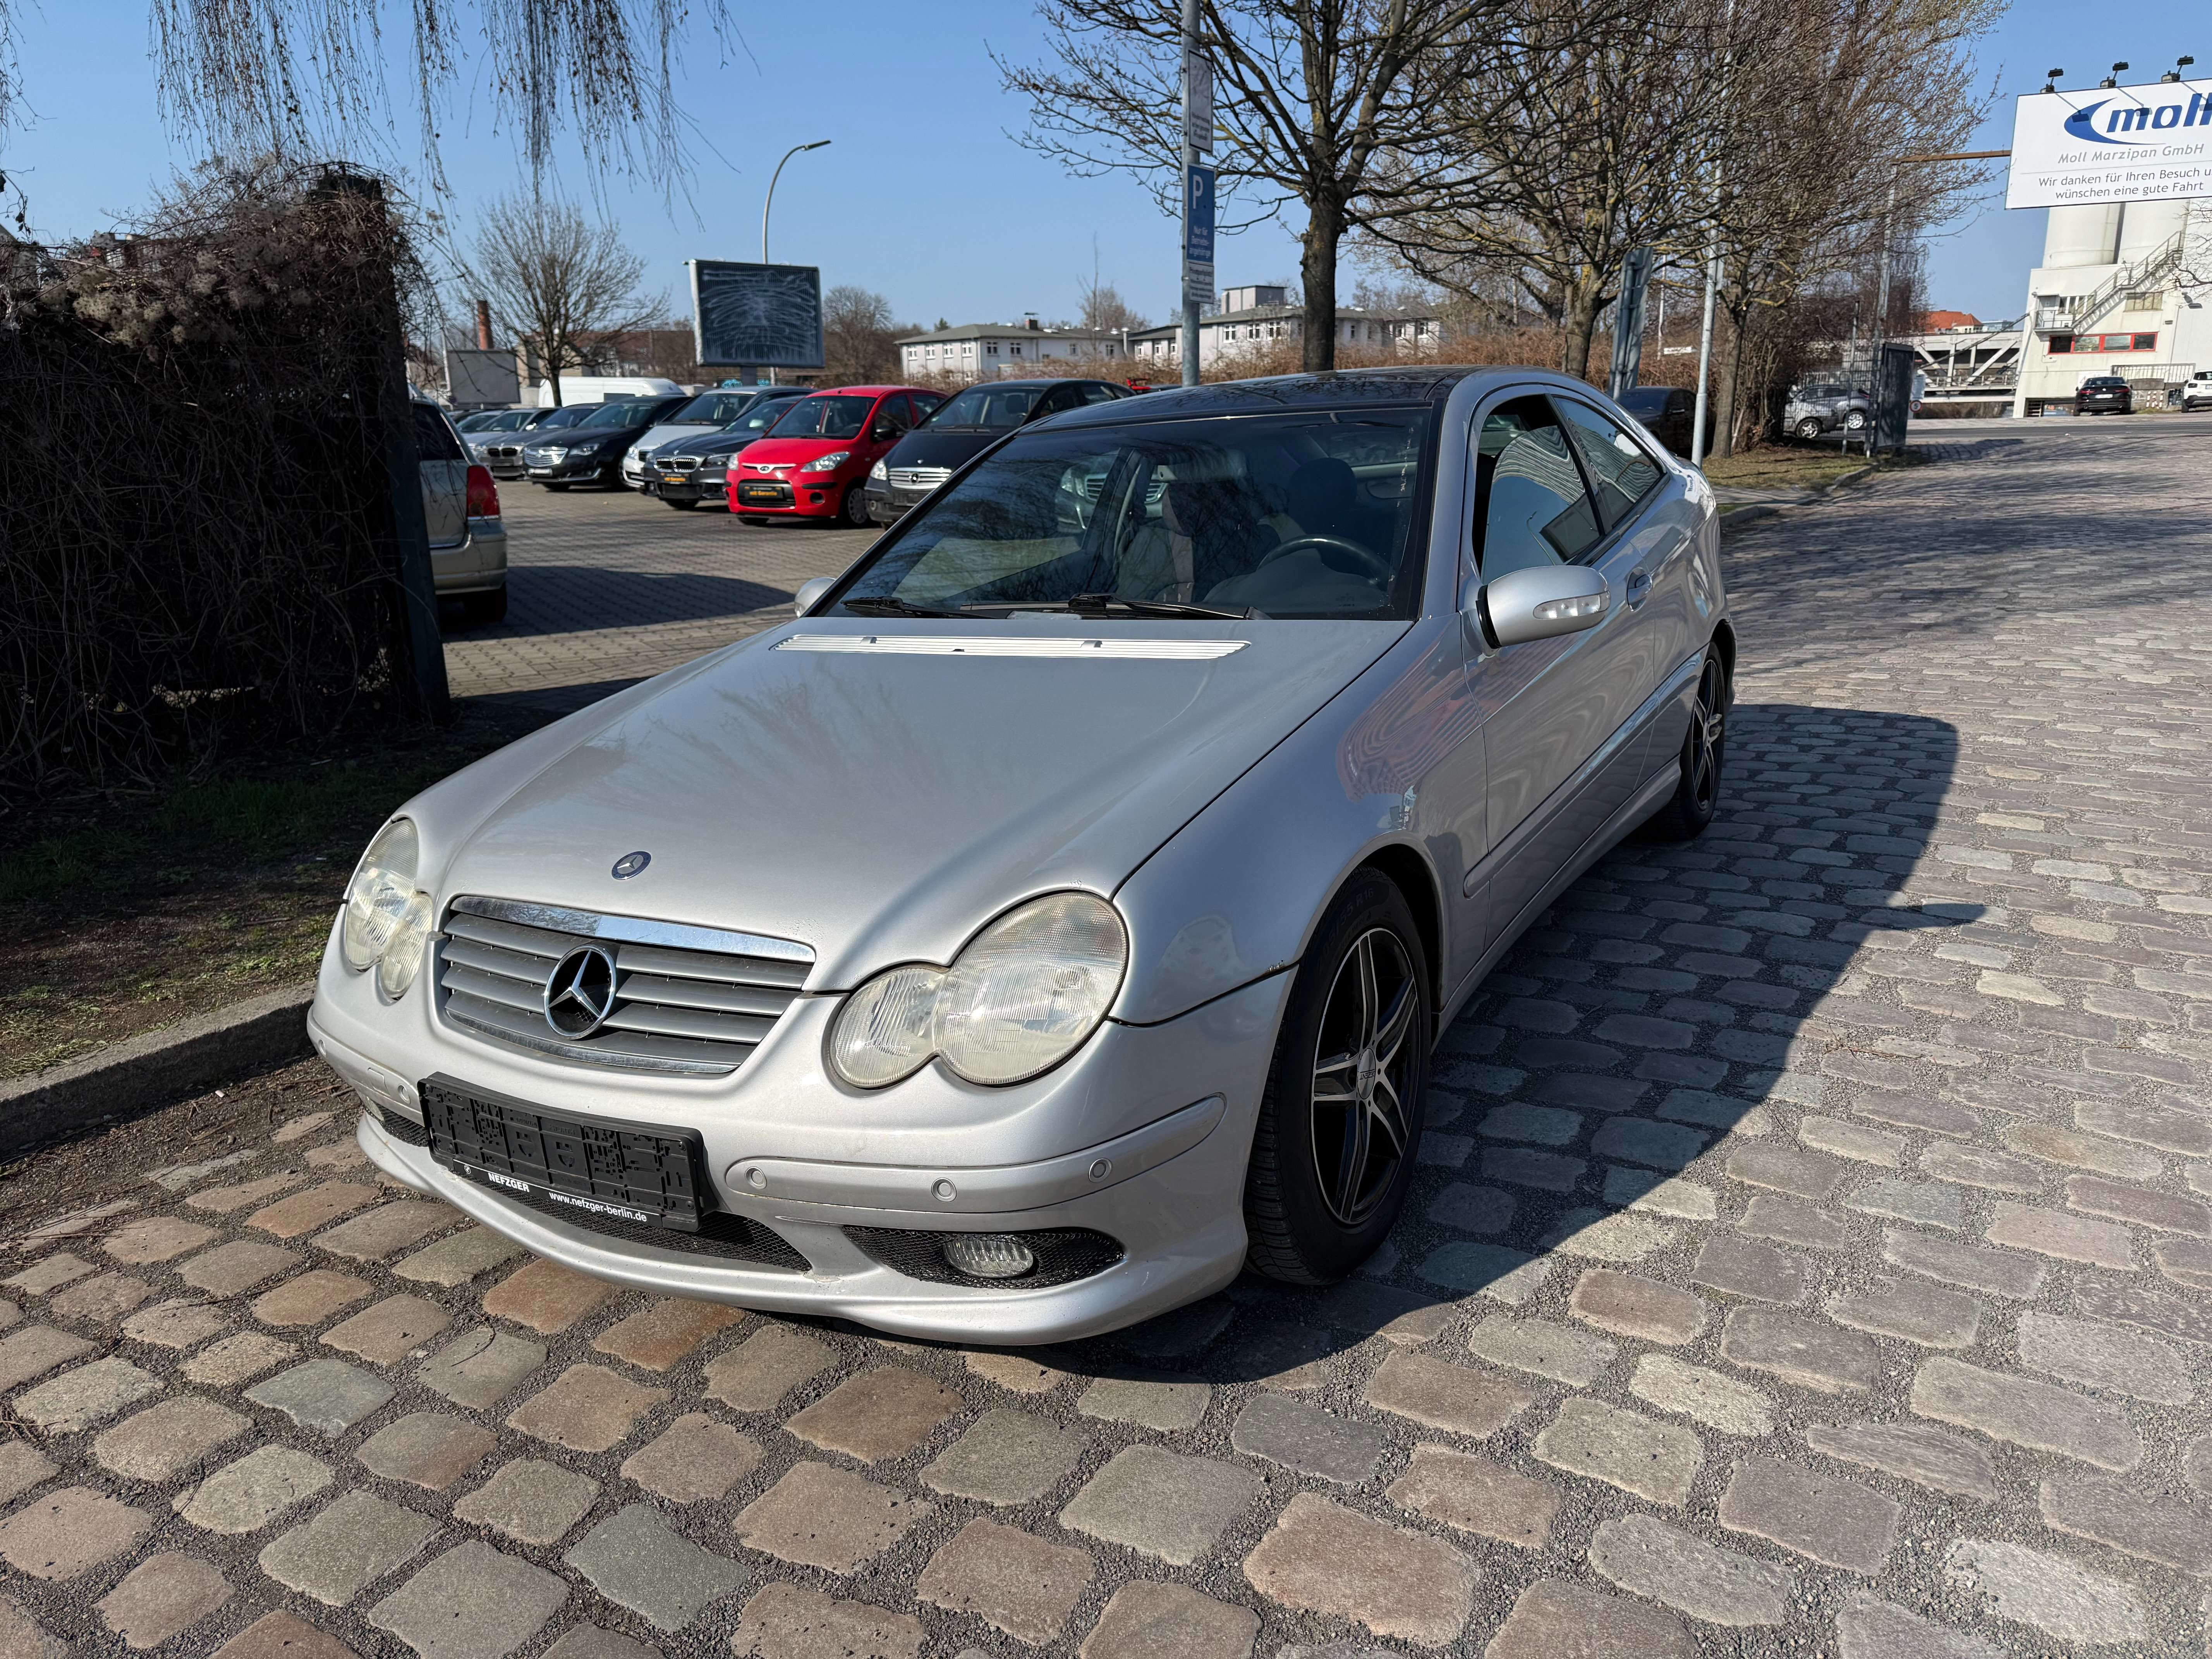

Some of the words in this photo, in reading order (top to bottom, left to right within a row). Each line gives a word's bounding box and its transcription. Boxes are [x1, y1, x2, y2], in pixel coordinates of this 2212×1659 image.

[2106, 92, 2212, 133] moll
[2057, 152, 2087, 164] Moll
[2092, 148, 2157, 161] Marzipan
[2162, 143, 2205, 156] GmbH
[2039, 177, 2057, 187] Wir
[2061, 175, 2101, 185] danken
[2106, 172, 2122, 183] für
[2126, 171, 2155, 181] Ihren
[2159, 167, 2200, 179] Besuch
[1193, 175, 1203, 209] P
[2055, 187, 2110, 199] wünschen
[2114, 185, 2138, 195] eine
[2142, 184, 2168, 196] gute
[2172, 181, 2204, 192] Fahrt
[488, 1172, 530, 1192] NEFZGER
[549, 1192, 647, 1222] www.nefzger-berlin.de
